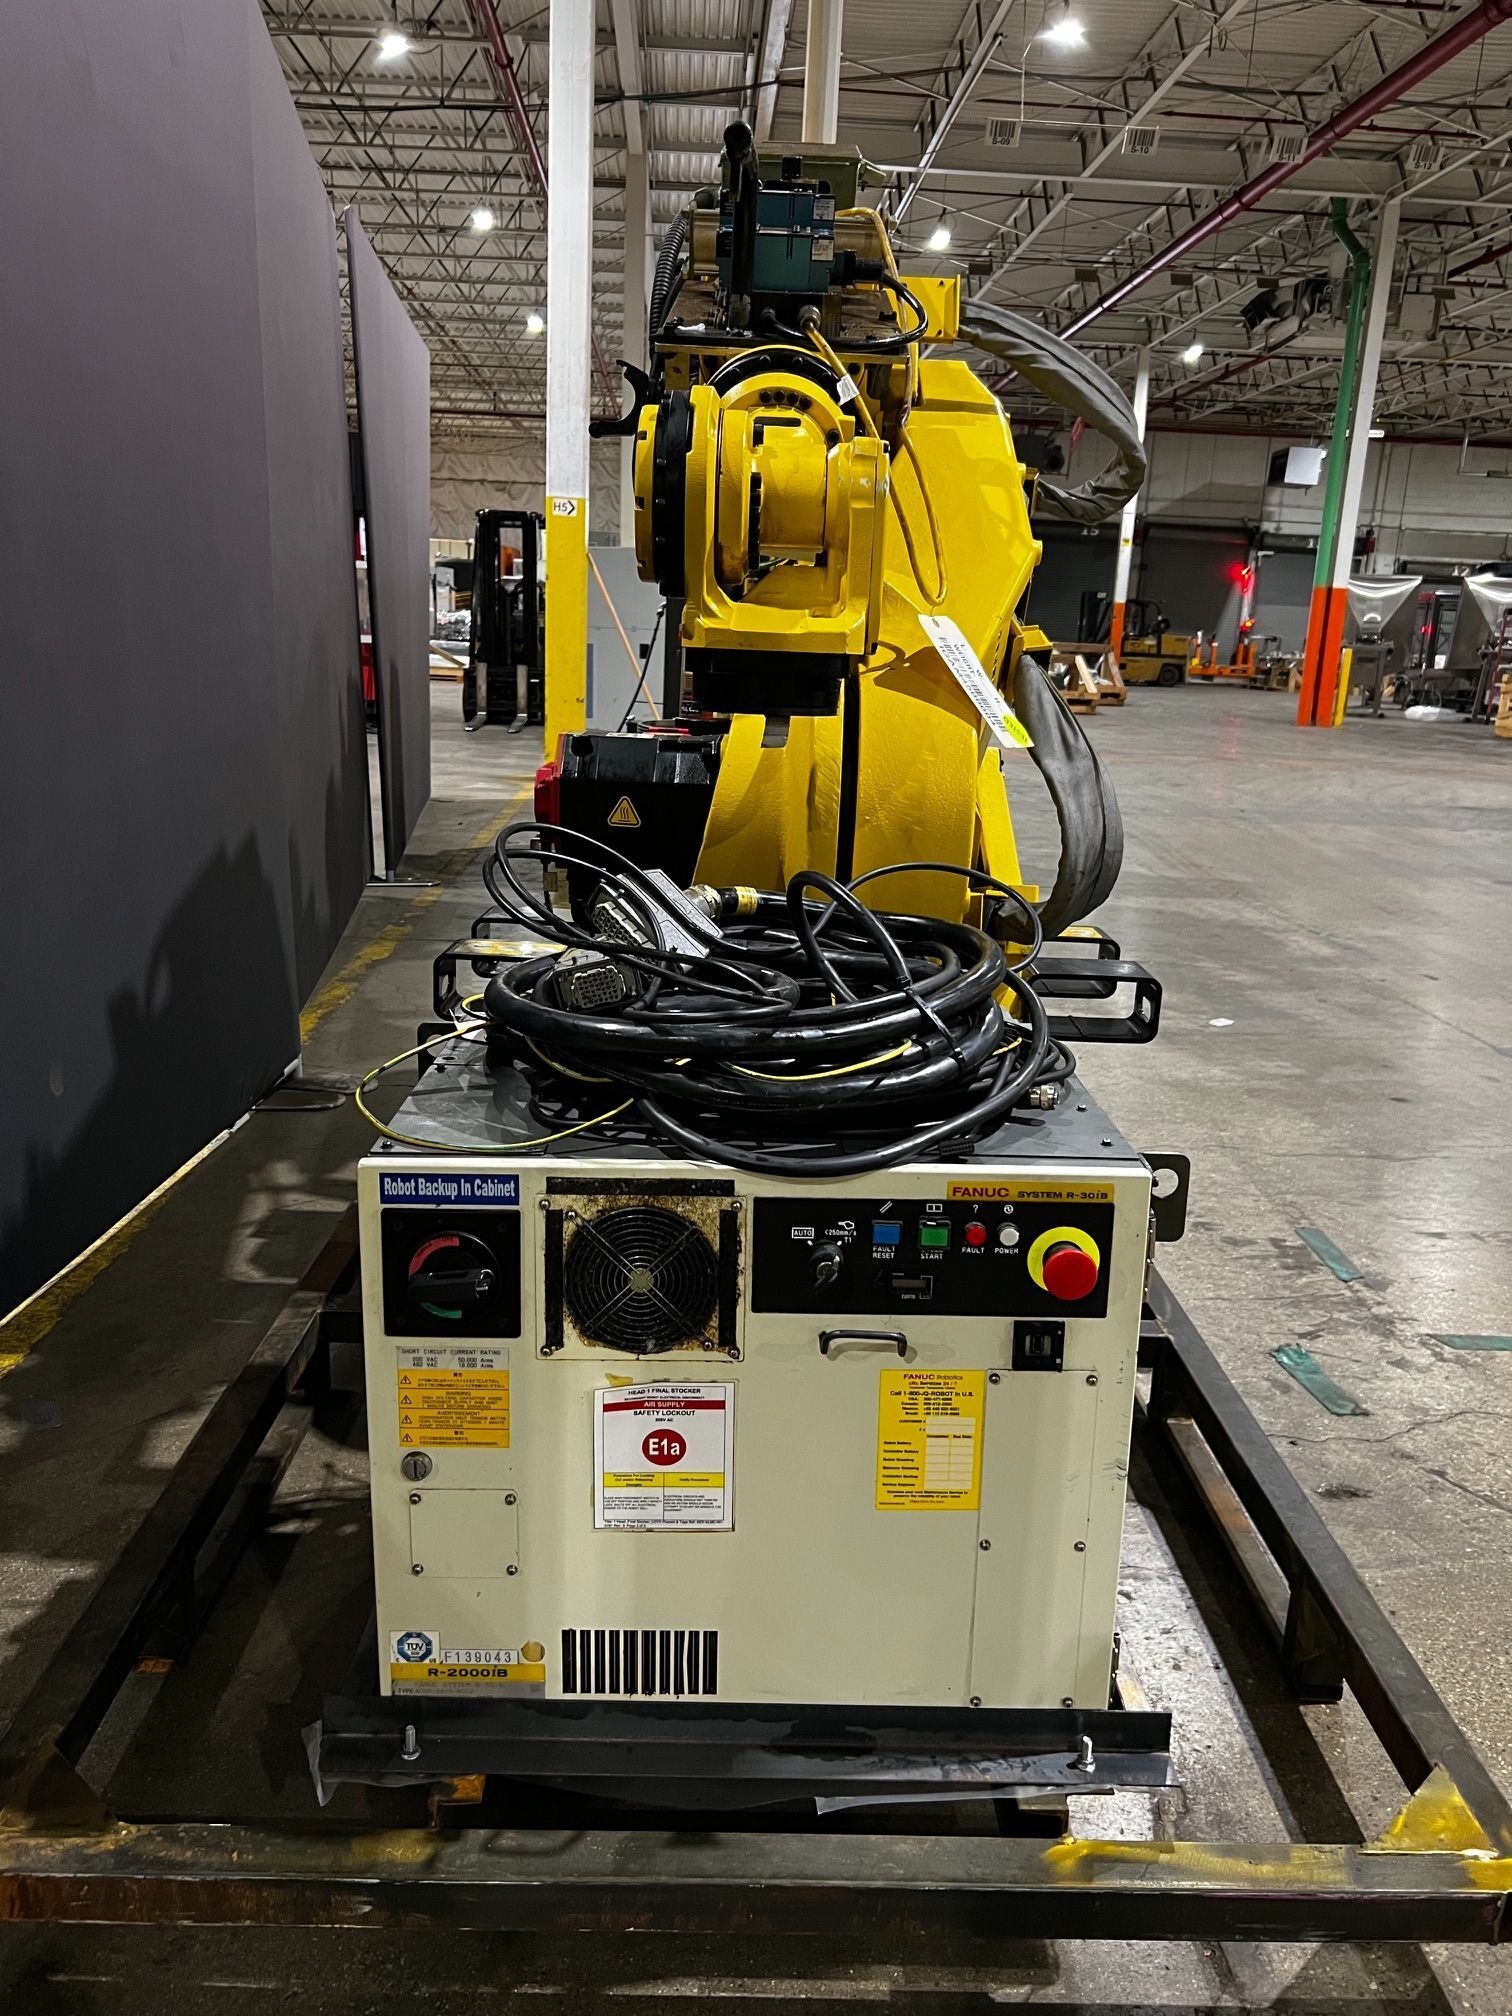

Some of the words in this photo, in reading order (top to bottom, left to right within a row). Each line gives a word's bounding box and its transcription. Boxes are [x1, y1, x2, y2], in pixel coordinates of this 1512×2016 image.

[991, 137, 1010, 146] S-09
[1131, 146, 1149, 154] S-10
[1278, 153, 1296, 162] S-11
[1413, 161, 1432, 170] S-12
[553, 502, 568, 512] H5
[384, 1177, 415, 1196] Robot
[418, 1178, 458, 1200] Backup
[461, 1178, 471, 1196] In
[474, 1179, 515, 1197] Cabinet
[952, 1187, 1010, 1198] FANUC
[1017, 1191, 1062, 1199] SYSTEM
[1066, 1190, 1108, 1200] R-30iB
[962, 1246, 984, 1254] FAULT
[649, 1438, 680, 1456] E1a
[444, 1651, 512, 1663] F139043
[428, 1665, 508, 1678] R-2000iB
